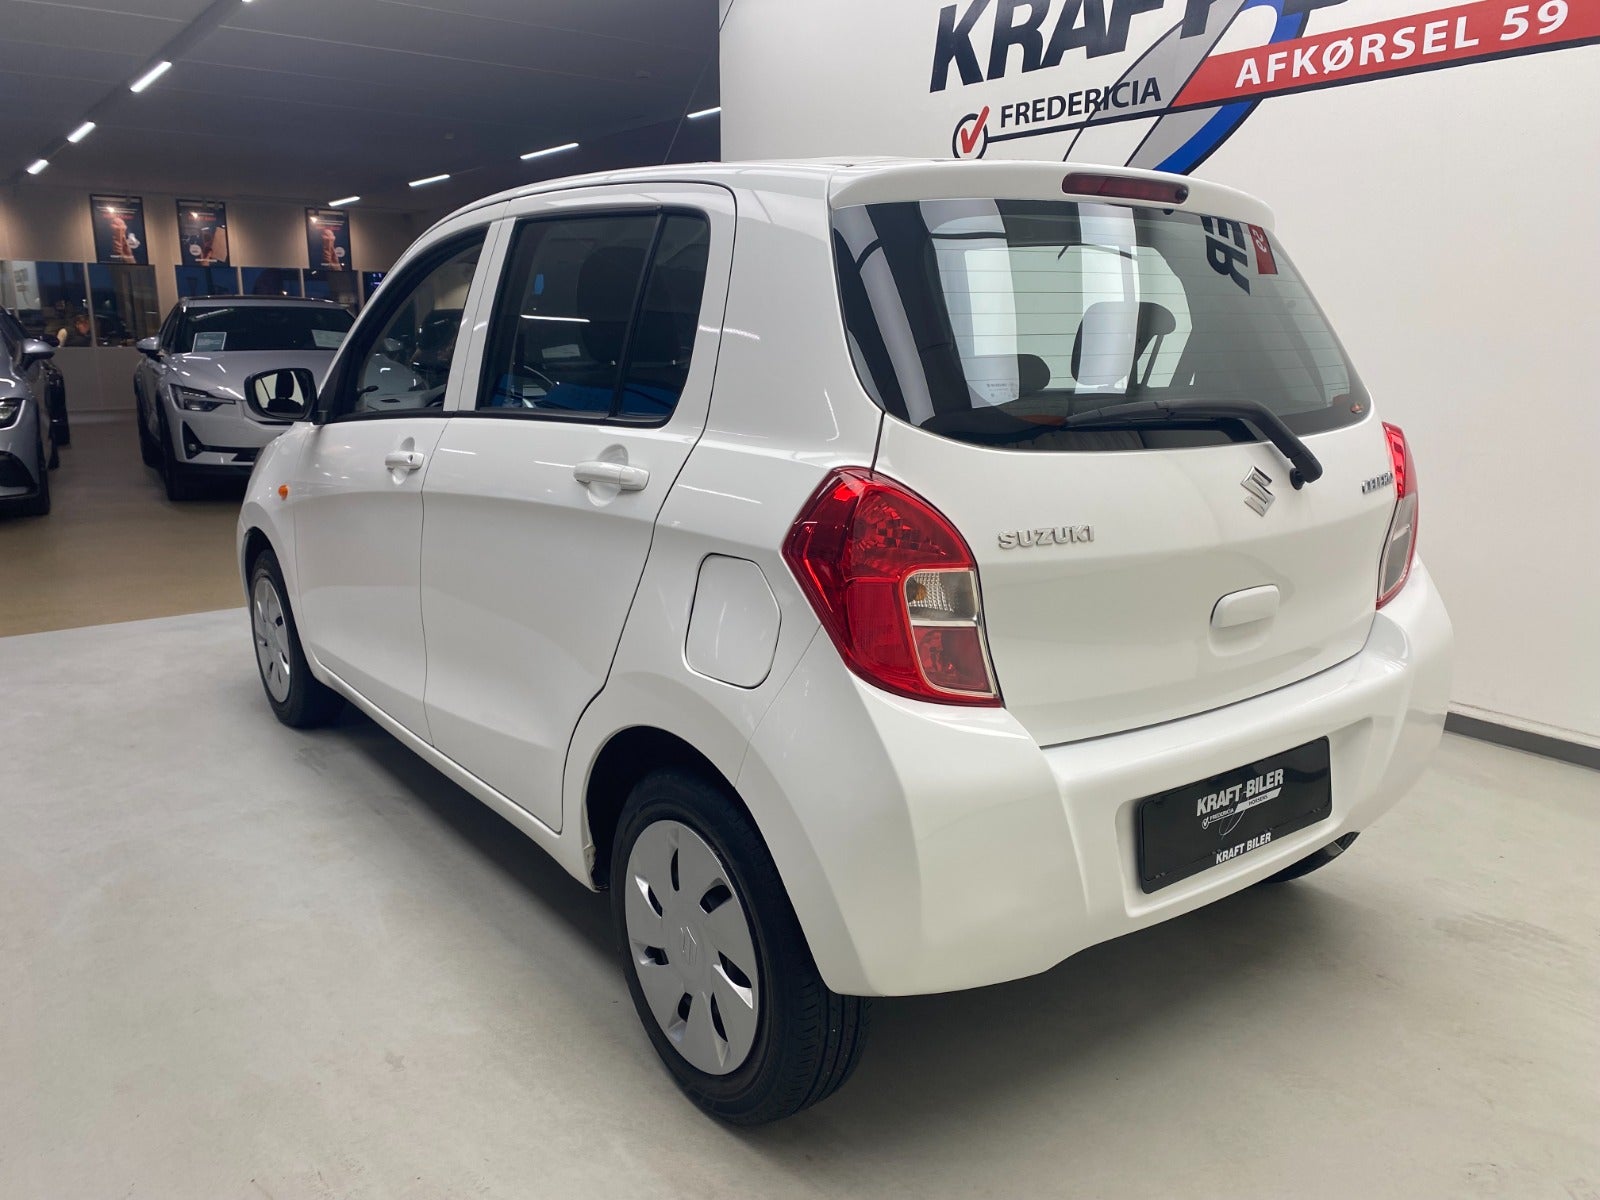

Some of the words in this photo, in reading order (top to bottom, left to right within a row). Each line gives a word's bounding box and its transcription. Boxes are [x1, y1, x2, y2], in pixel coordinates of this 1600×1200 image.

[1234, 16, 1480, 89] AFKØRSEL
[1500, 0, 1569, 41] 59
[1000, 77, 1162, 128] FREDERICIA
[997, 523, 1095, 550] SUZUKI
[1196, 783, 1243, 817] KRAFT
[1246, 768, 1284, 798] BILER
[1215, 842, 1245, 865] KRAFT
[1246, 832, 1271, 851] BILER
